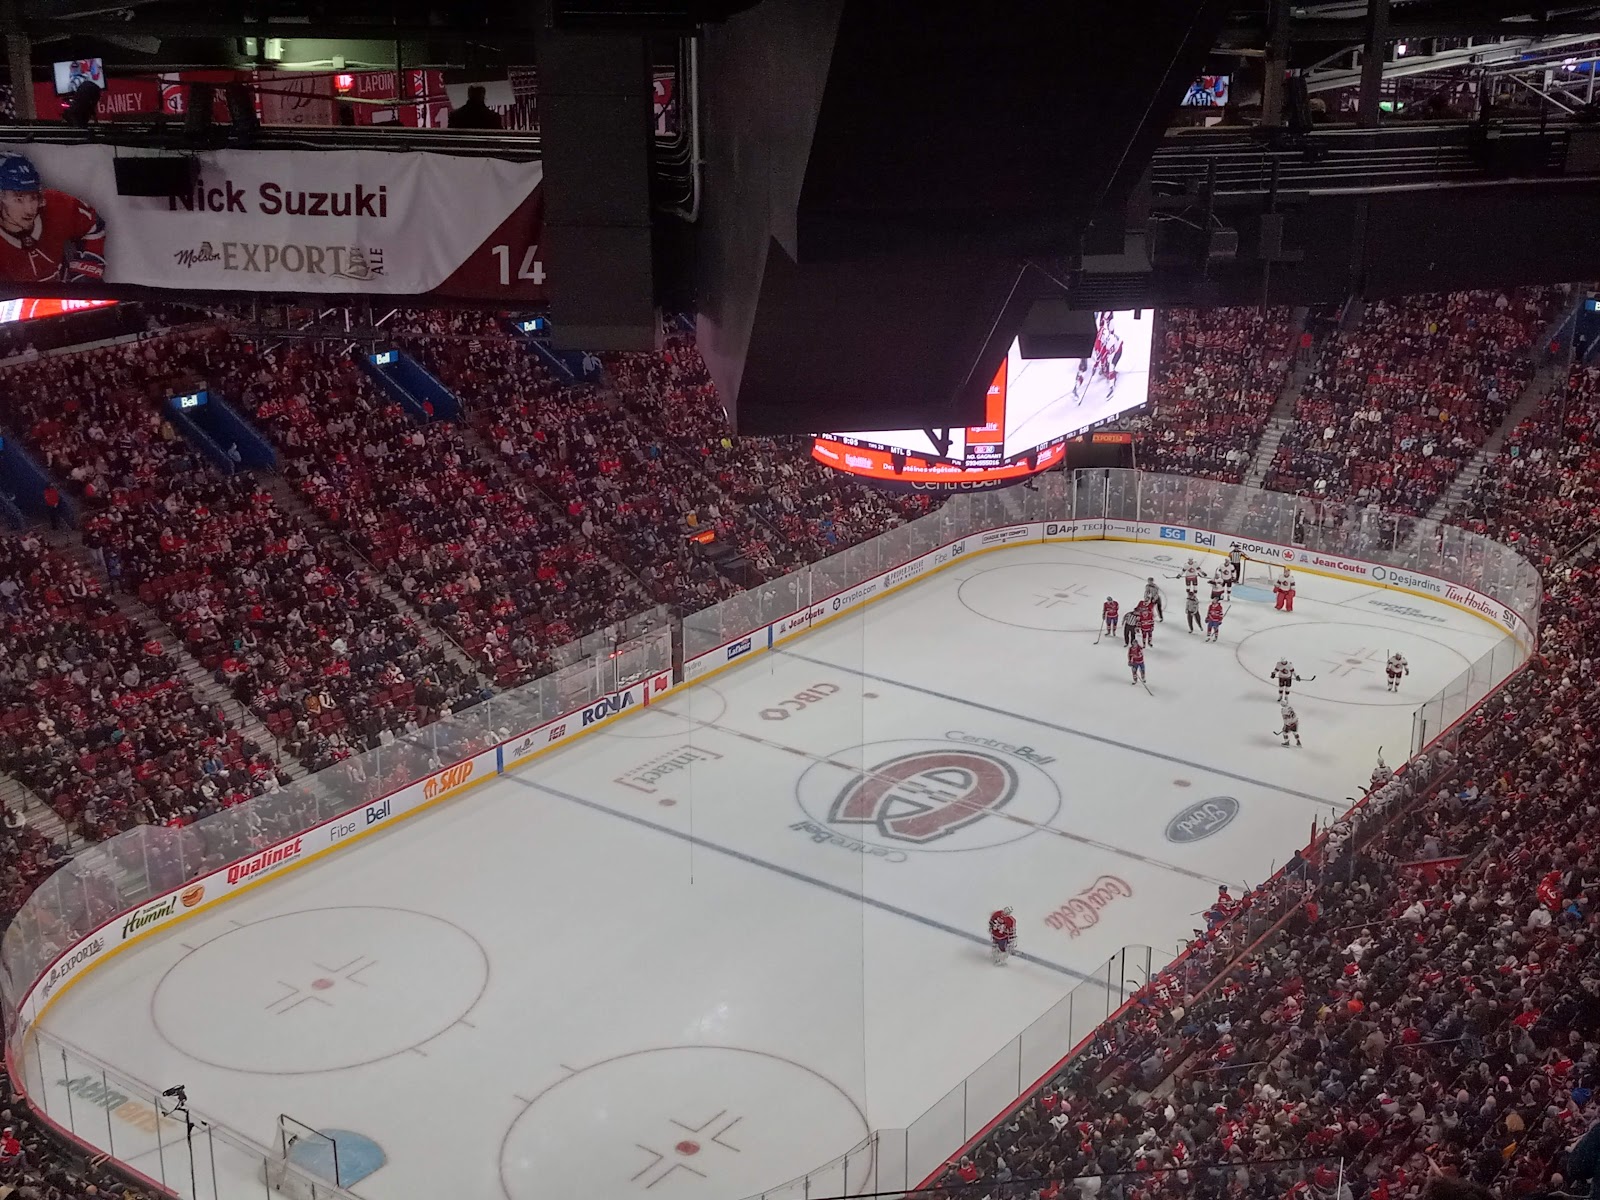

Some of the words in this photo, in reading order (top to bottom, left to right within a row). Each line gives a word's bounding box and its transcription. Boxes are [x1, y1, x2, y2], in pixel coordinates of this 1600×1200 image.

[97, 92, 142, 114] GAINEY
[258, 181, 387, 218] Suzuki
[174, 246, 222, 269] Molson
[222, 242, 347, 275] EXPORT
[370, 247, 384, 275] ALE
[491, 244, 547, 286] 14
[523, 320, 536, 331] Bell
[376, 352, 390, 365] Bell
[181, 394, 198, 408] Bell
[890, 446, 905, 456] MTL
[933, 552, 948, 566] Fibe
[951, 541, 966, 557] Bell
[1164, 528, 1181, 539] 5G
[1194, 530, 1216, 547] Bell
[1228, 541, 1280, 558] AEROPLAN
[841, 583, 877, 605] crypto.com
[1389, 571, 1441, 593] Desjardins
[1444, 583, 1464, 601] Tim
[1464, 592, 1499, 620] Hortons
[582, 691, 635, 727] RONA
[778, 683, 841, 711] CIBC
[944, 730, 1056, 765] CentreBell
[438, 760, 474, 795] SKIP
[632, 752, 707, 786] intact
[329, 821, 356, 842] Fibe
[365, 799, 391, 826] Bell
[1177, 803, 1228, 834] Ford
[227, 837, 303, 885] Qualinet
[122, 896, 178, 940] Humm!
[60, 942, 94, 978] EXPORT
